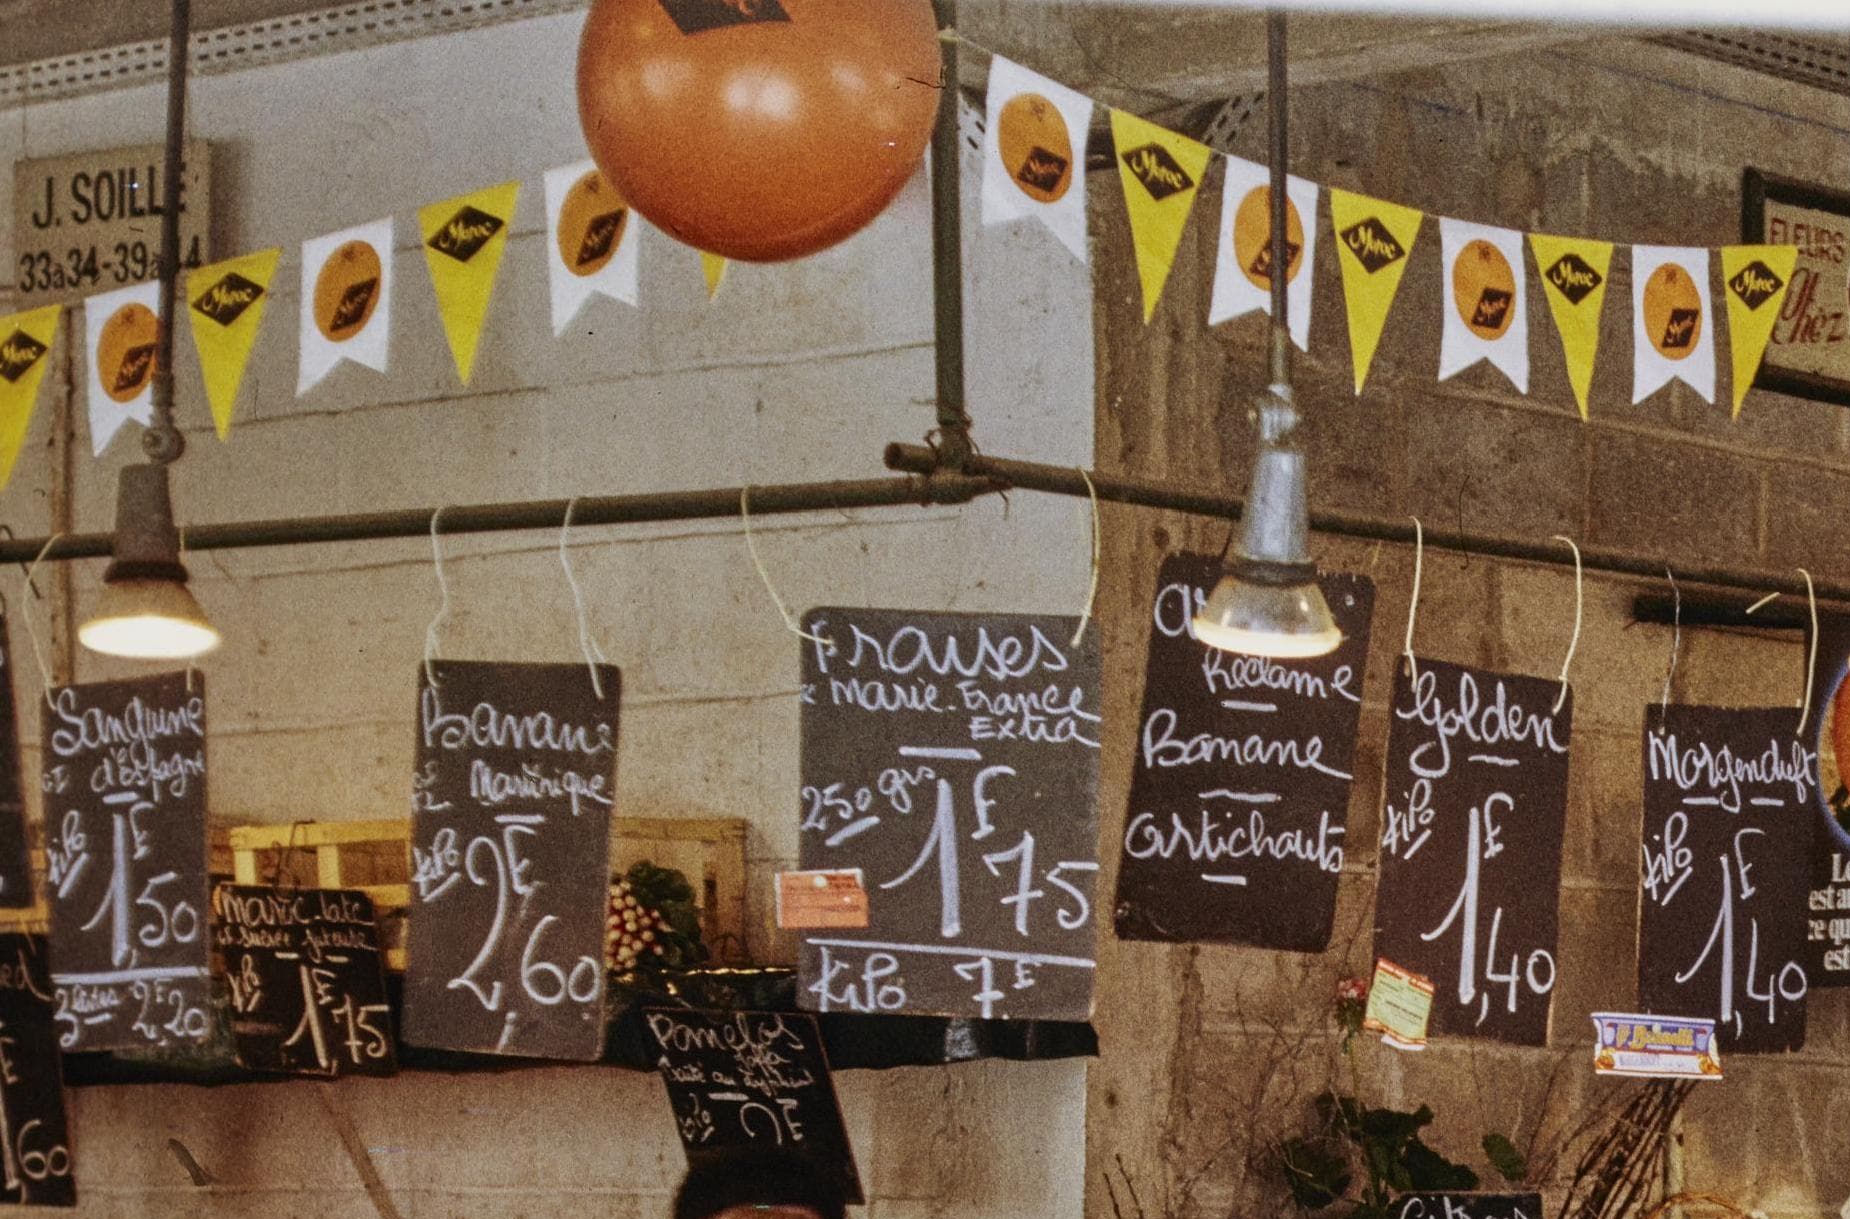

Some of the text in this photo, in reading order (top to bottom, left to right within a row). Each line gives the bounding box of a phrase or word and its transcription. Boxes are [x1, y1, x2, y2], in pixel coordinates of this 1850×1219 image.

[32, 176, 61, 228] J.
[1809, 884, 1835, 910] est
[1824, 944, 1850, 970] est
